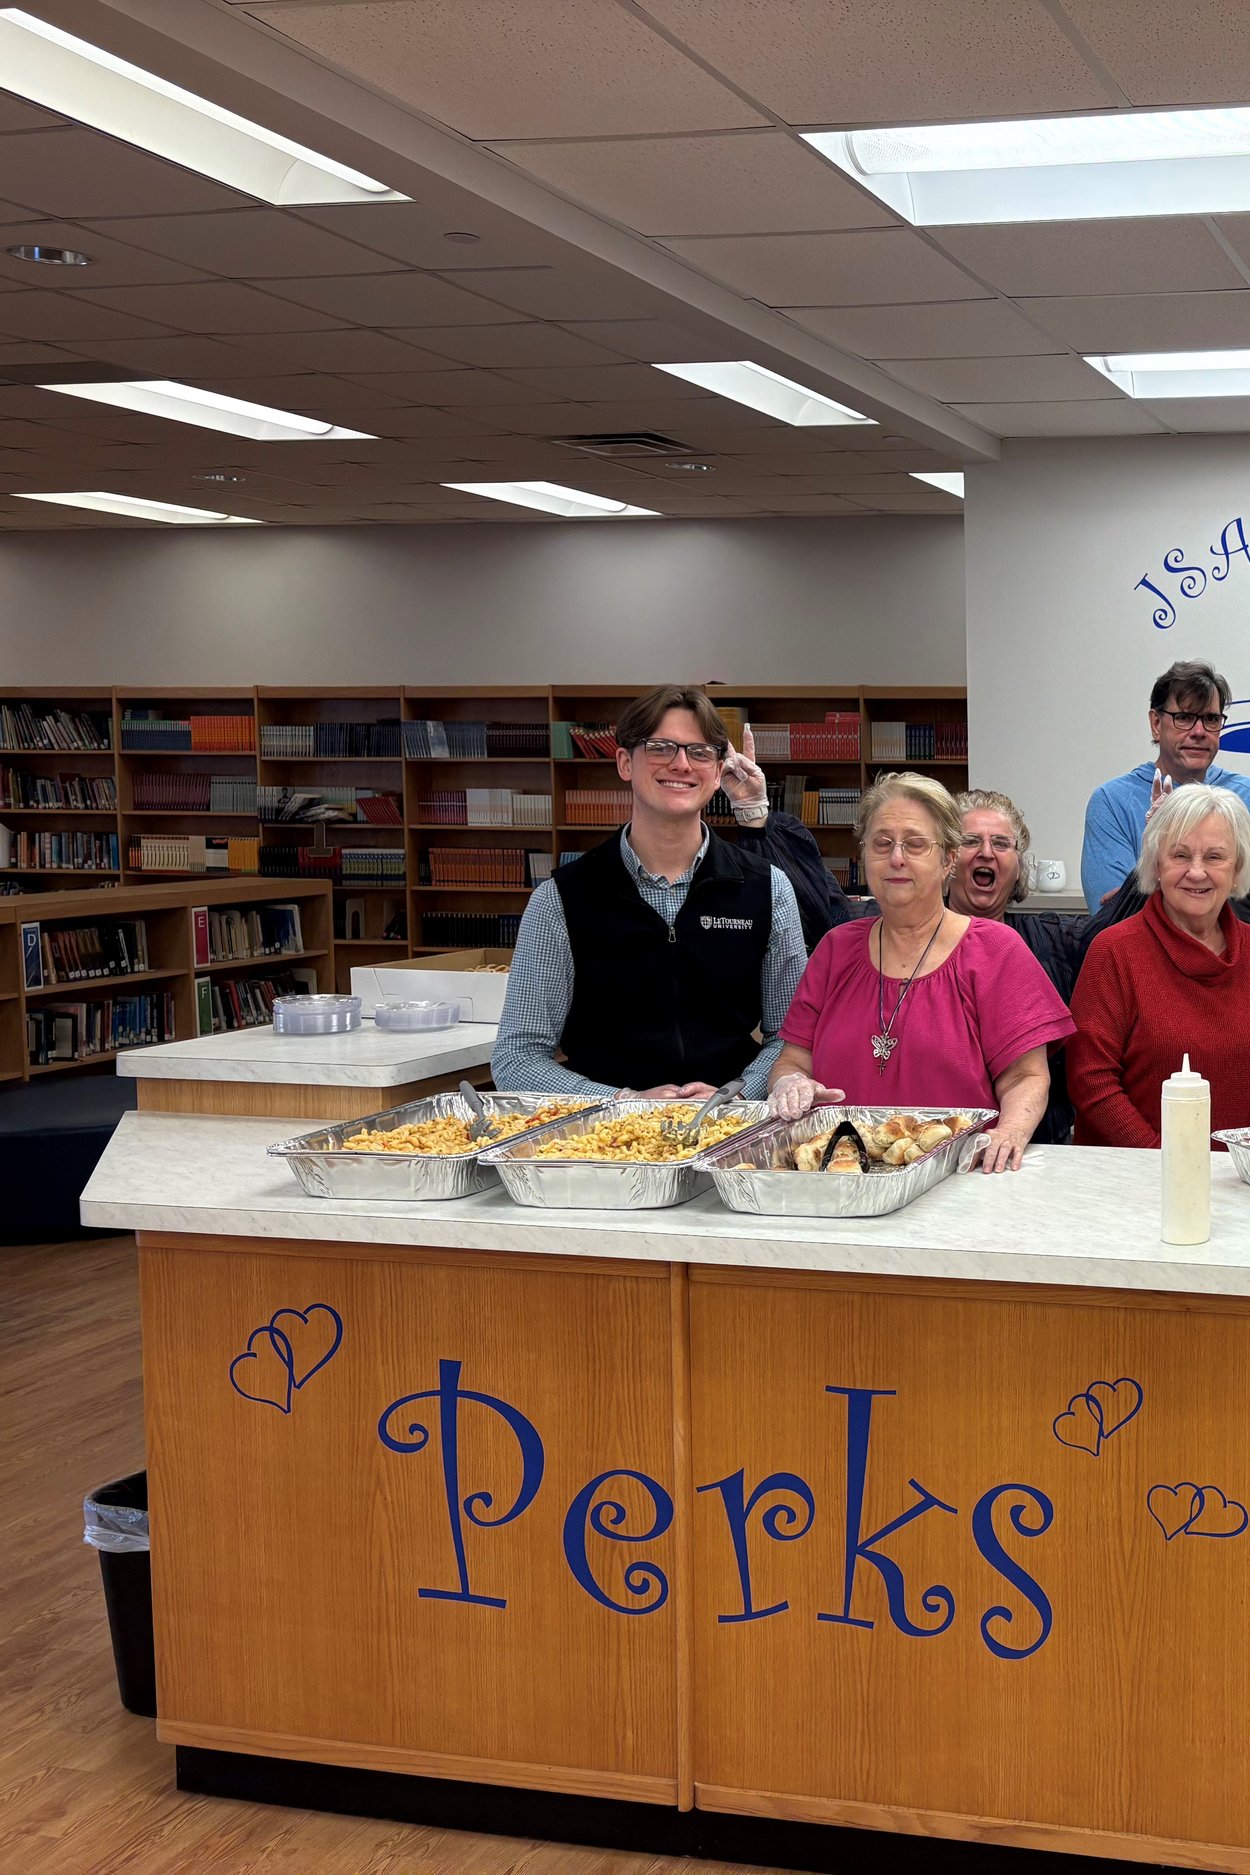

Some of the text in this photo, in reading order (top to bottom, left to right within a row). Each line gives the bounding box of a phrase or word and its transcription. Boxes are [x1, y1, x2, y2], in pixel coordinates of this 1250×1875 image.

[198, 916, 205, 928] E
[27, 933, 37, 946] D
[201, 986, 208, 999] F
[376, 1358, 1055, 1660] Perks
